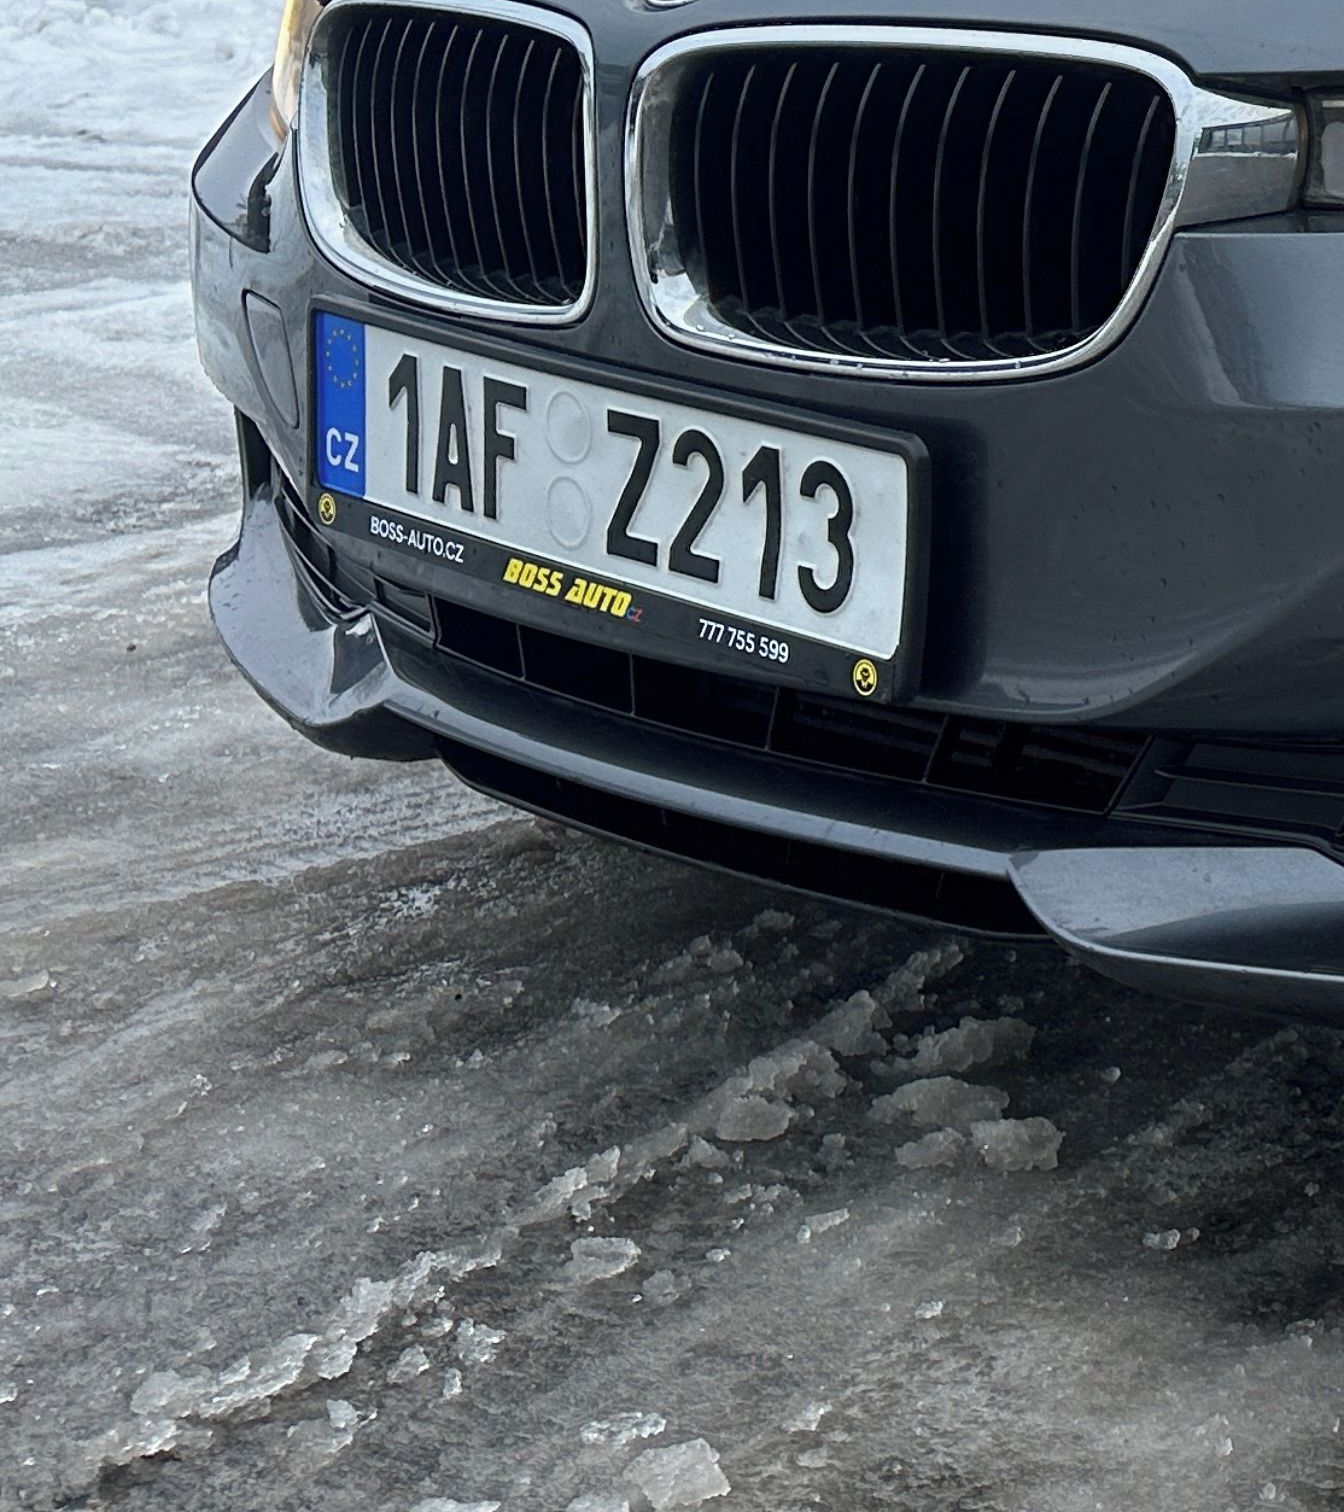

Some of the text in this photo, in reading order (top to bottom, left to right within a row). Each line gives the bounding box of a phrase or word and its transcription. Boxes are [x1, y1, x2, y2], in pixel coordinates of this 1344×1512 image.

[325, 426, 360, 473] CZ
[388, 353, 856, 615] 1AF Z213
[370, 516, 465, 564] BOSS-AUTO.CZ
[503, 557, 564, 597] BOSS
[565, 578, 632, 618] AUTO
[699, 618, 789, 663] 777 755 599
